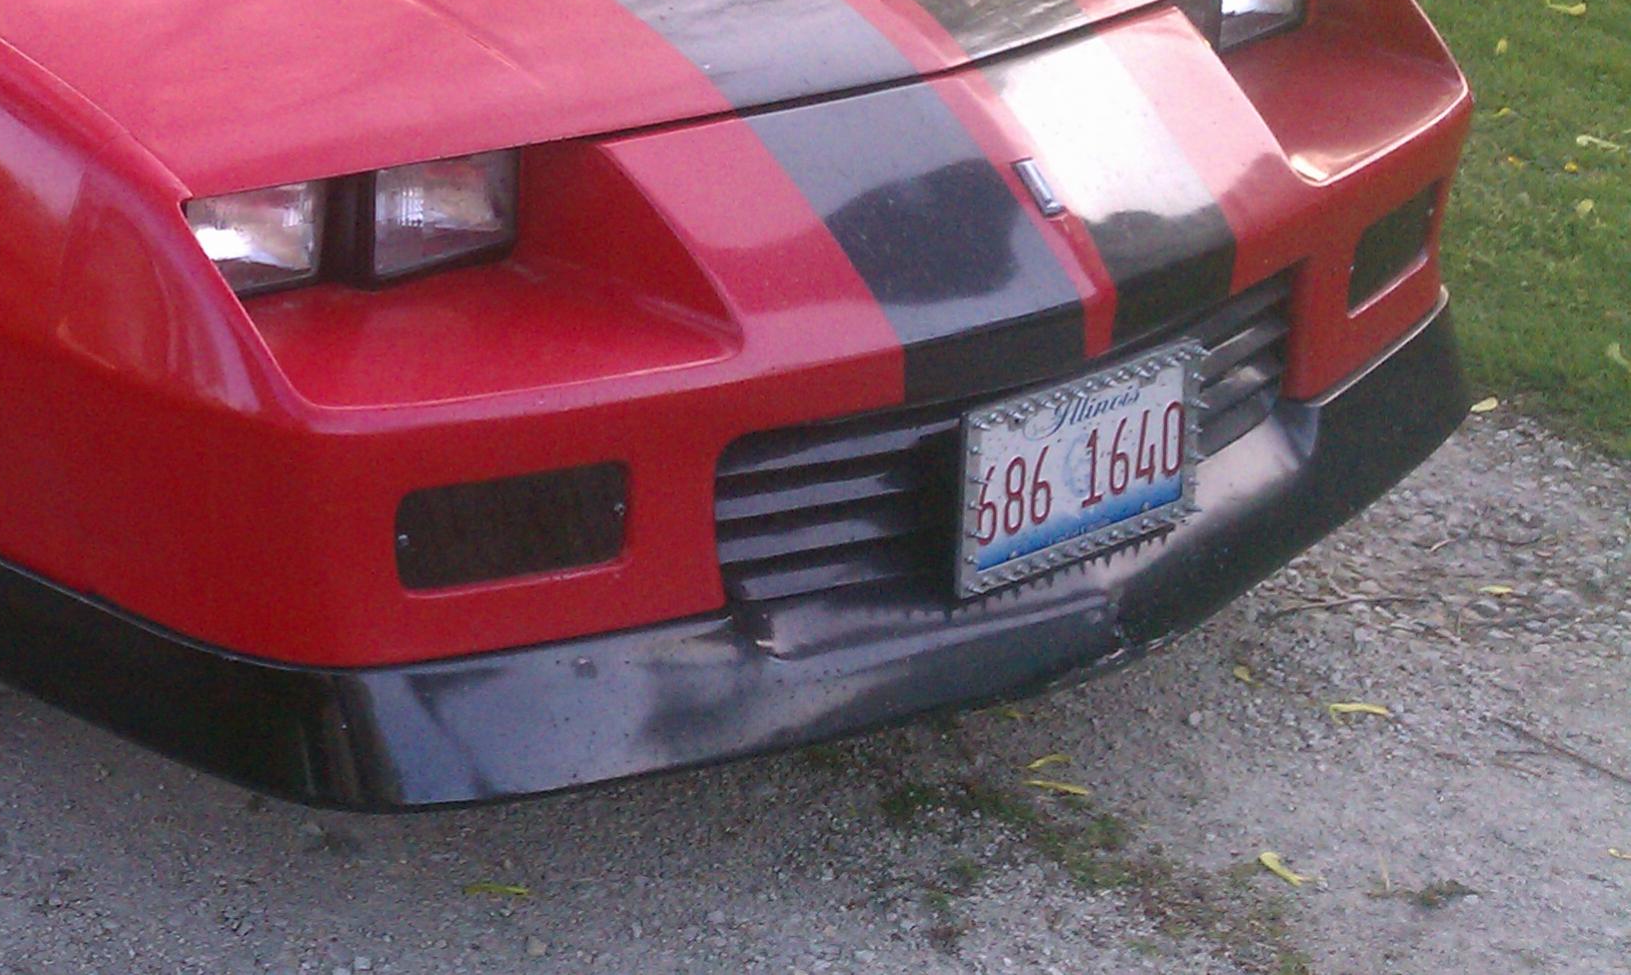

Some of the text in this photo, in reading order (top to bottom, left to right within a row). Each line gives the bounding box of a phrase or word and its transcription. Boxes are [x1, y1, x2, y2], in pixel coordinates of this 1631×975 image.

[1023, 384, 1141, 442] Illinois
[977, 400, 1185, 546] 686 1640
